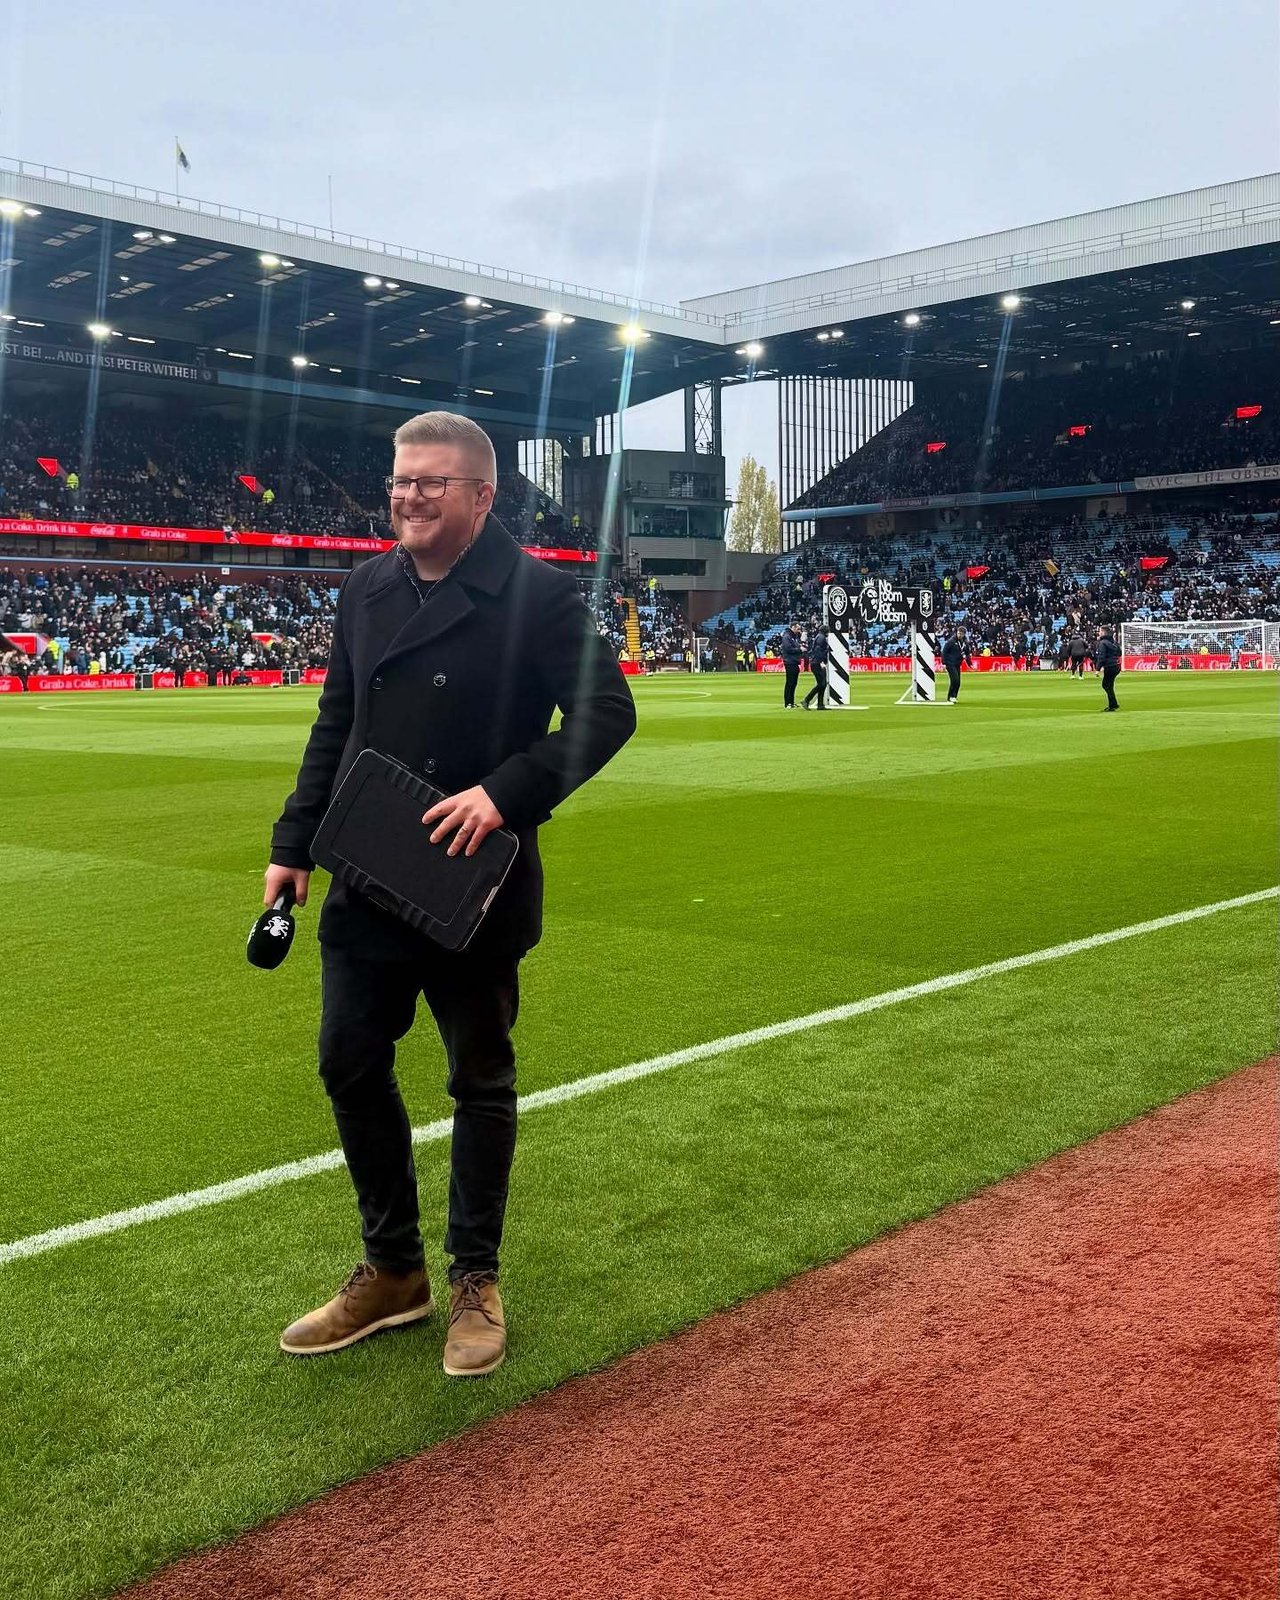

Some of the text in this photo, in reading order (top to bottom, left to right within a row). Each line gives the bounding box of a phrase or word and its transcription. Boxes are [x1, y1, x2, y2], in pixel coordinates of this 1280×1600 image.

[23, 345, 41, 358] BE!
[117, 358, 152, 373] PETER
[1146, 476, 1183, 489] AVFC
[1195, 471, 1224, 484] THE
[37, 523, 59, 533] Drink
[879, 579, 892, 593] No
[880, 607, 907, 622] racism
[872, 661, 897, 672] Drink
[40, 680, 64, 689] Grab
[102, 678, 128, 688] Drink
